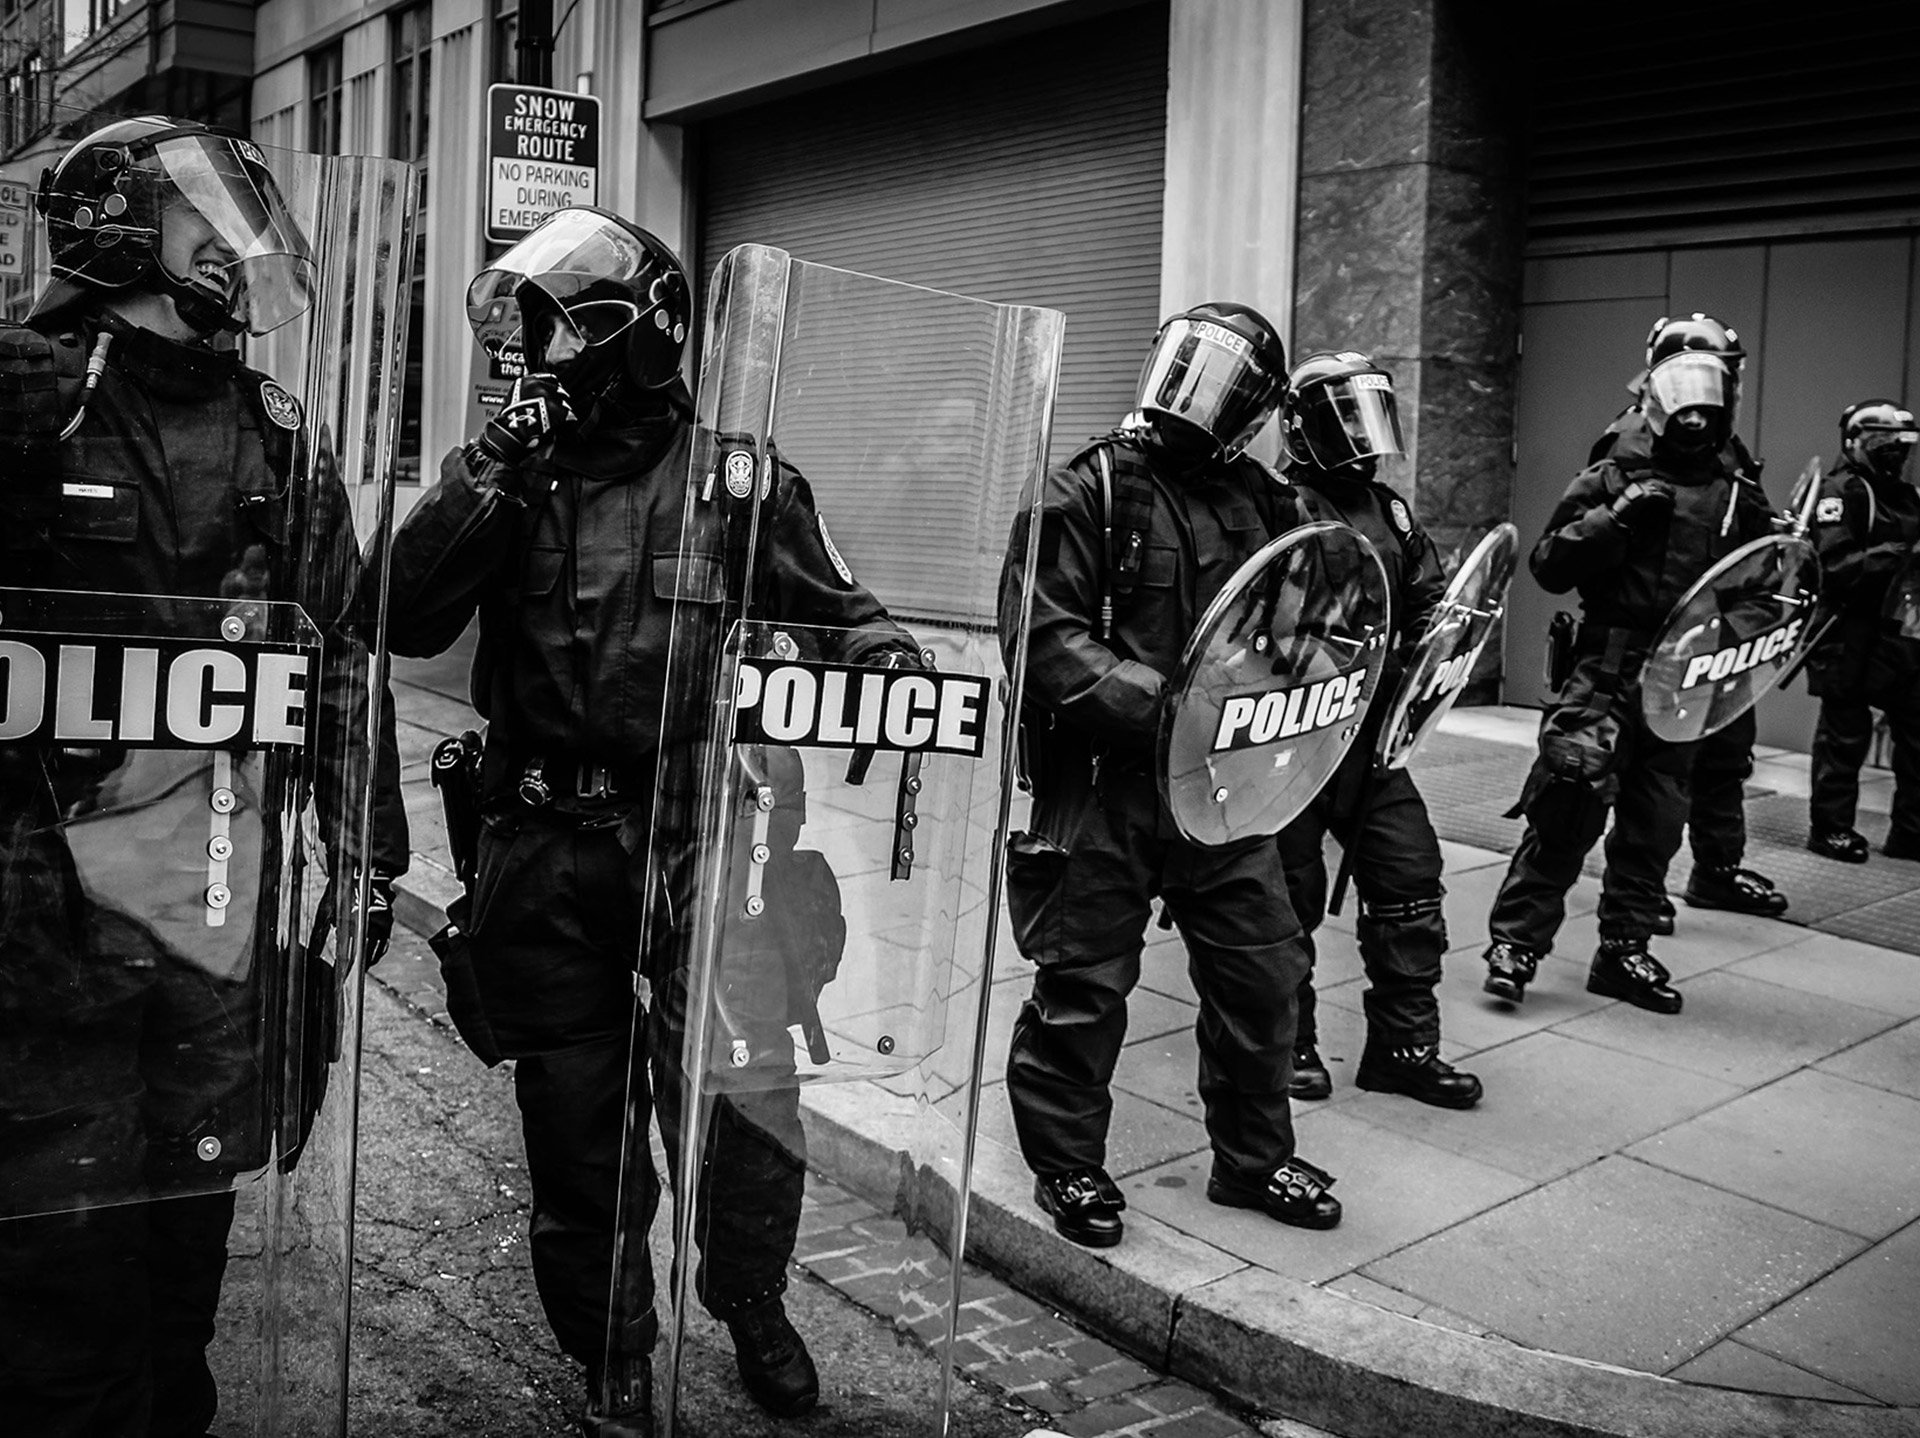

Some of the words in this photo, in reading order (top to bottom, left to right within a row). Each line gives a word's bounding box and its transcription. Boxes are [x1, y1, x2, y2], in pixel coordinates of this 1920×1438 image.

[514, 94, 575, 121] SNOW
[504, 115, 587, 139] EMERGENCY
[517, 134, 575, 161] ROUTE
[498, 162, 521, 181] NO
[526, 165, 590, 188] PARKING
[517, 187, 572, 207] DURING
[1196, 323, 1243, 351] POLICE
[501, 363, 522, 376] the
[1681, 618, 1803, 689] POLICE
[1214, 668, 1367, 750] POLICE
